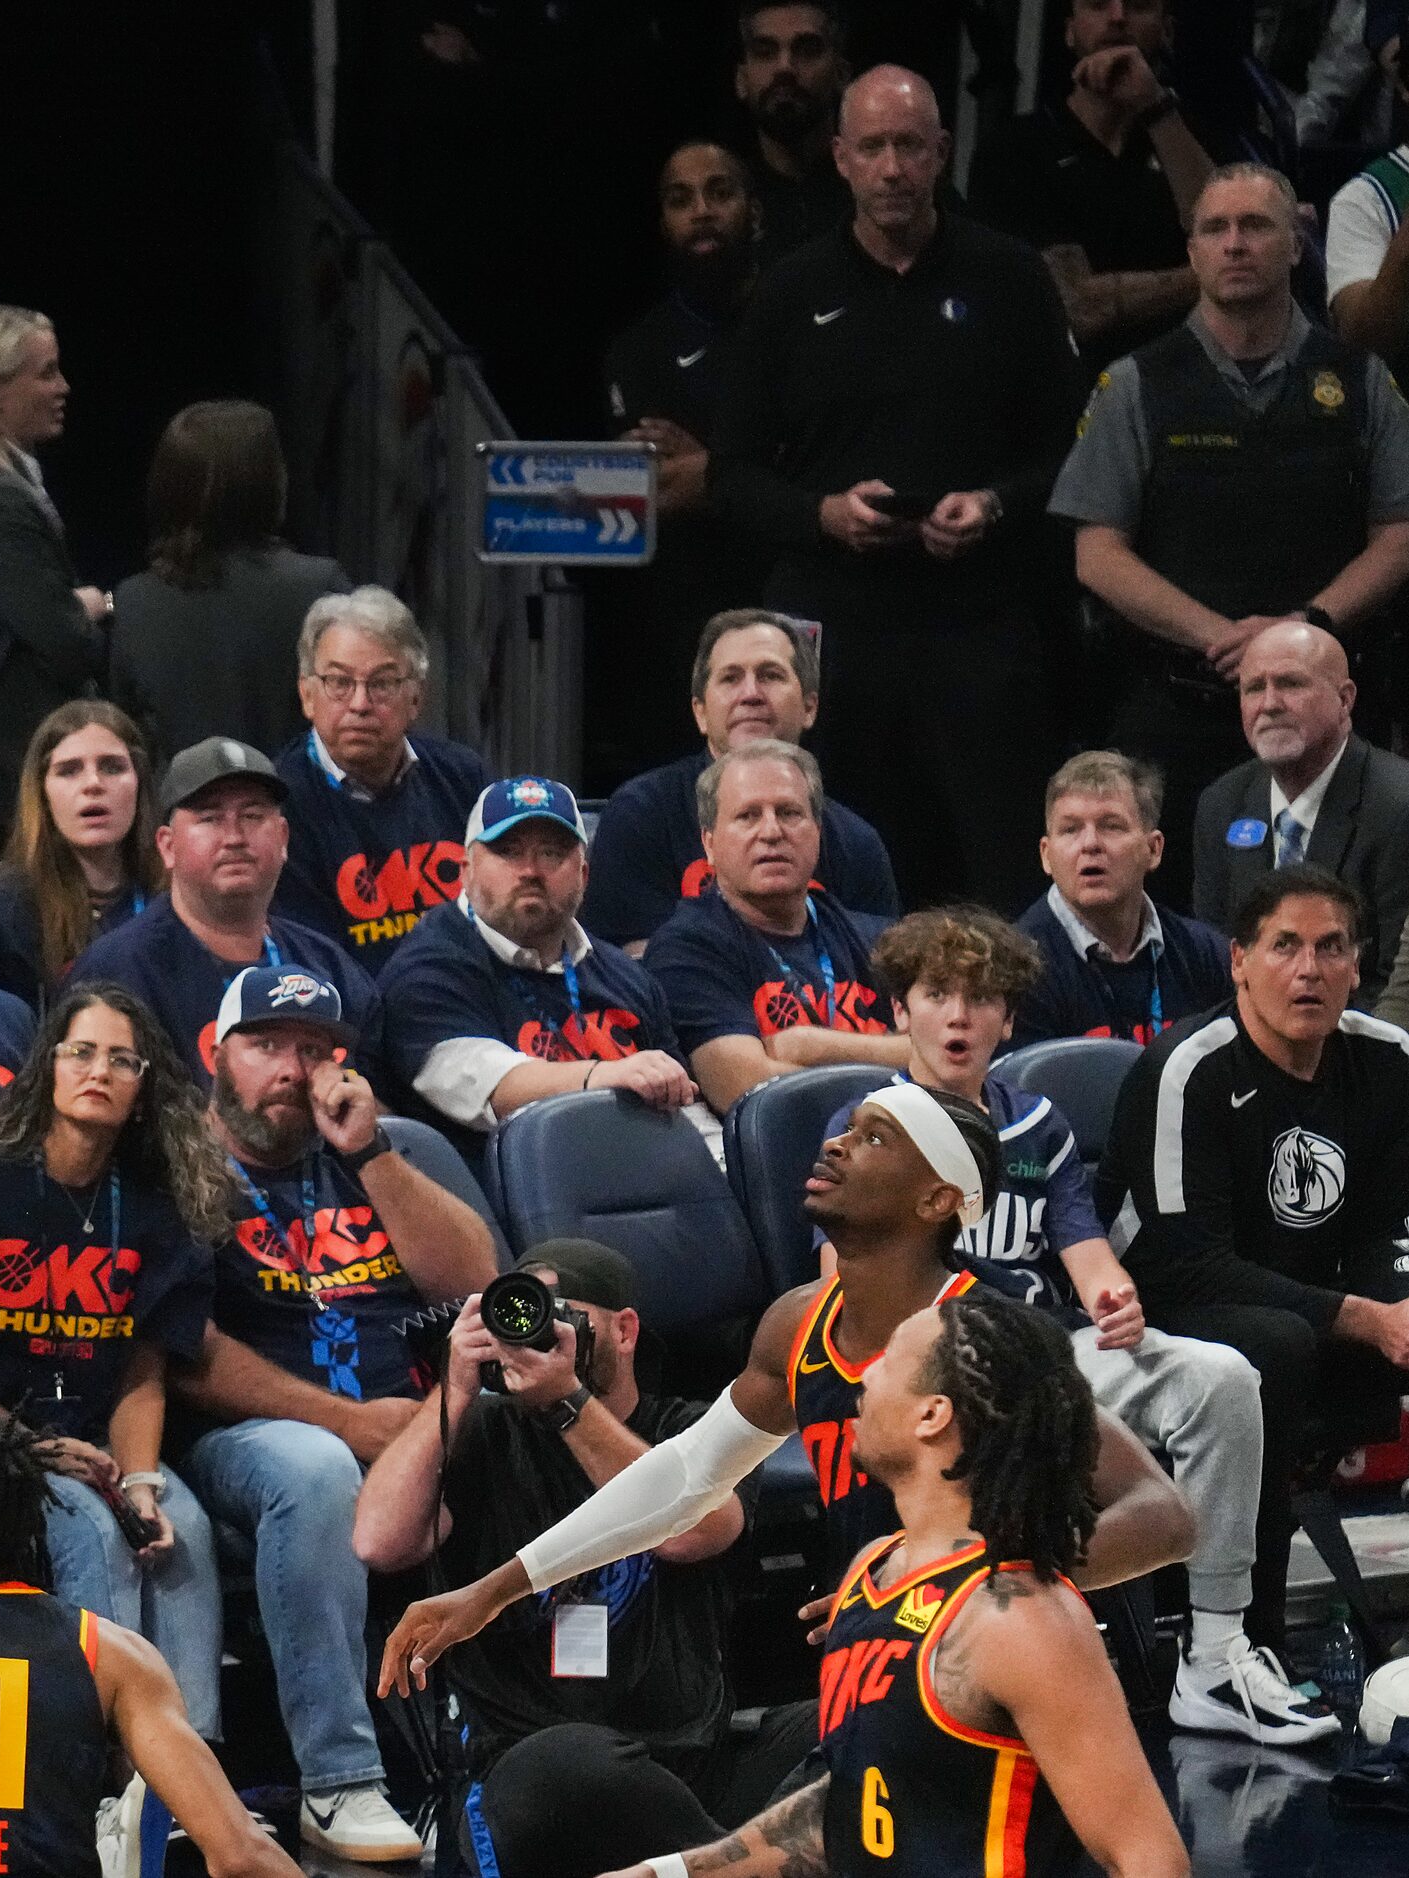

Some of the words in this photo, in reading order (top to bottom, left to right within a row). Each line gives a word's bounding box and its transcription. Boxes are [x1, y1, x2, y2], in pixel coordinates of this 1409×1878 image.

[495, 517, 588, 533] PLAYERS
[336, 841, 468, 920] OKC
[517, 1008, 640, 1062] OKC
[753, 980, 888, 1037] OKC
[237, 1206, 389, 1273] OKC
[258, 1254, 402, 1293] THUNDER
[819, 1637, 914, 1743] OKC
[861, 1766, 895, 1858] 6
